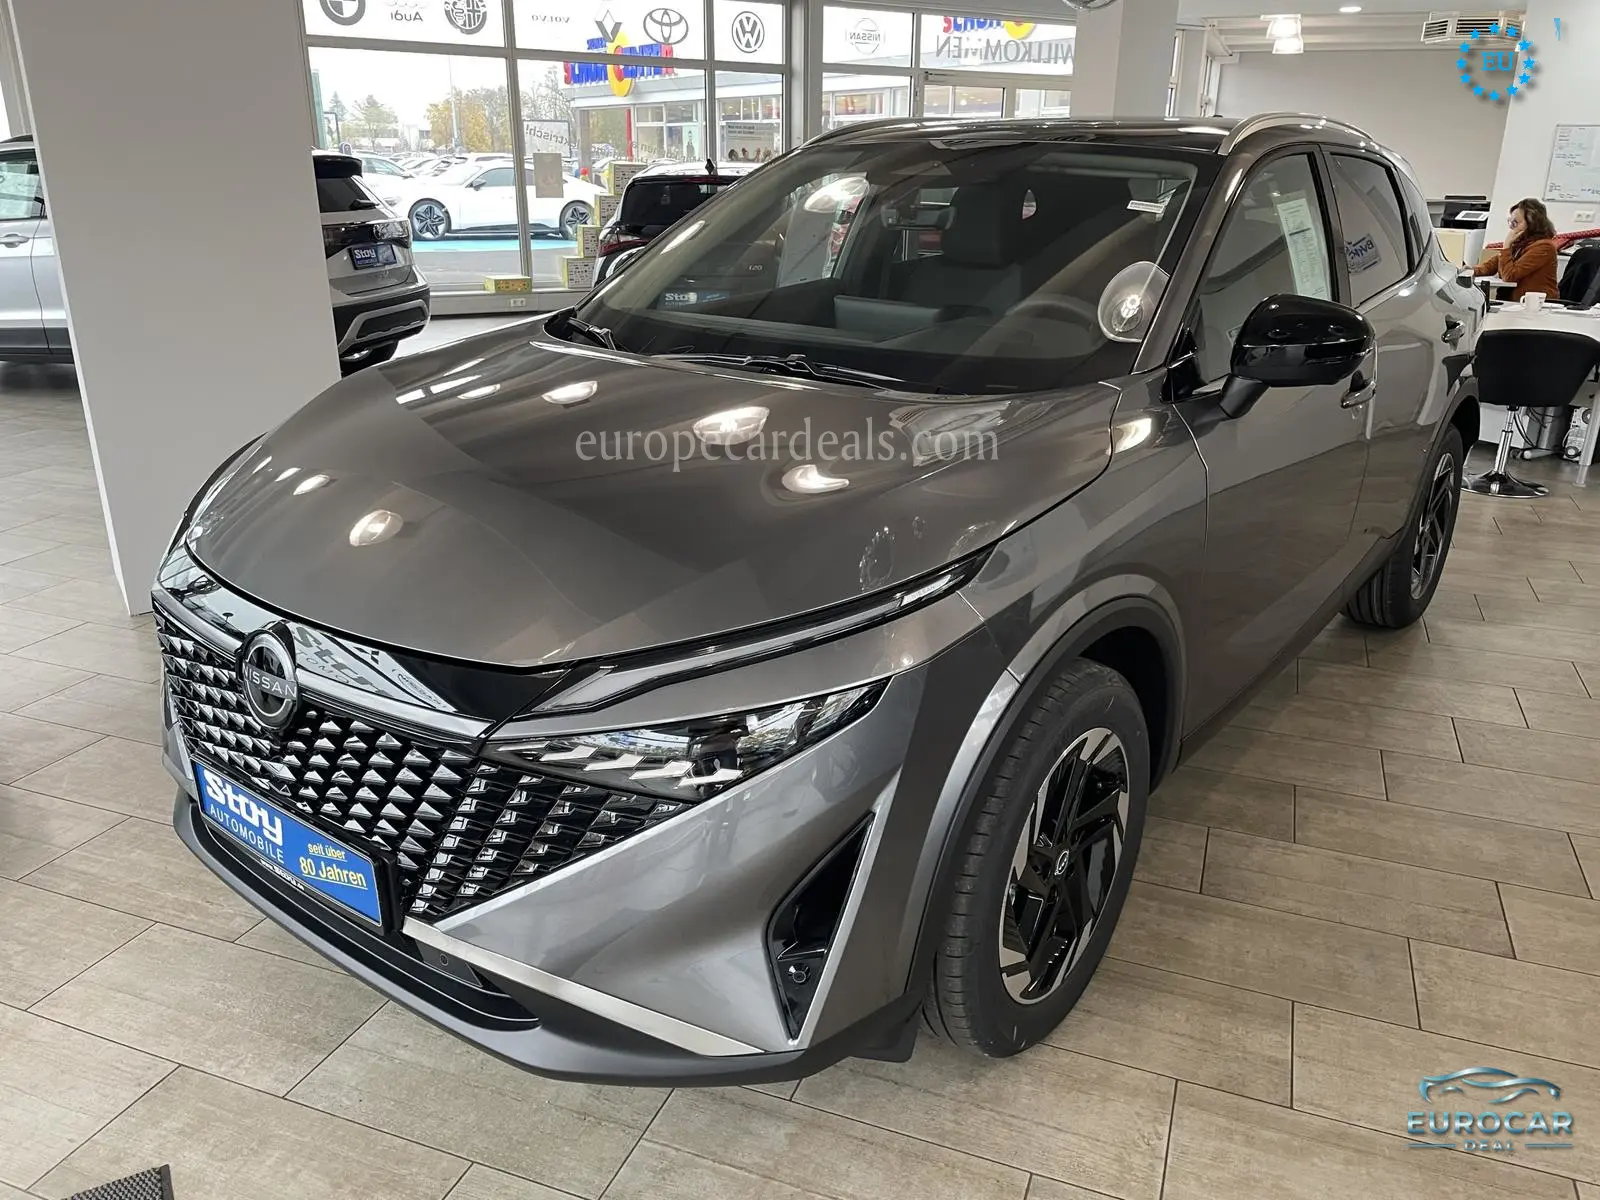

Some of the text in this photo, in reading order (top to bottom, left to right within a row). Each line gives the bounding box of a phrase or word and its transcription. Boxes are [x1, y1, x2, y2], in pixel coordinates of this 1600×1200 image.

[354, 249, 377, 259] Stoy
[203, 768, 283, 846] Stoy
[209, 803, 285, 865] AUTOMOBILE
[308, 843, 346, 860] seit über
[299, 856, 315, 876] 80
[319, 860, 367, 888] Jahren
